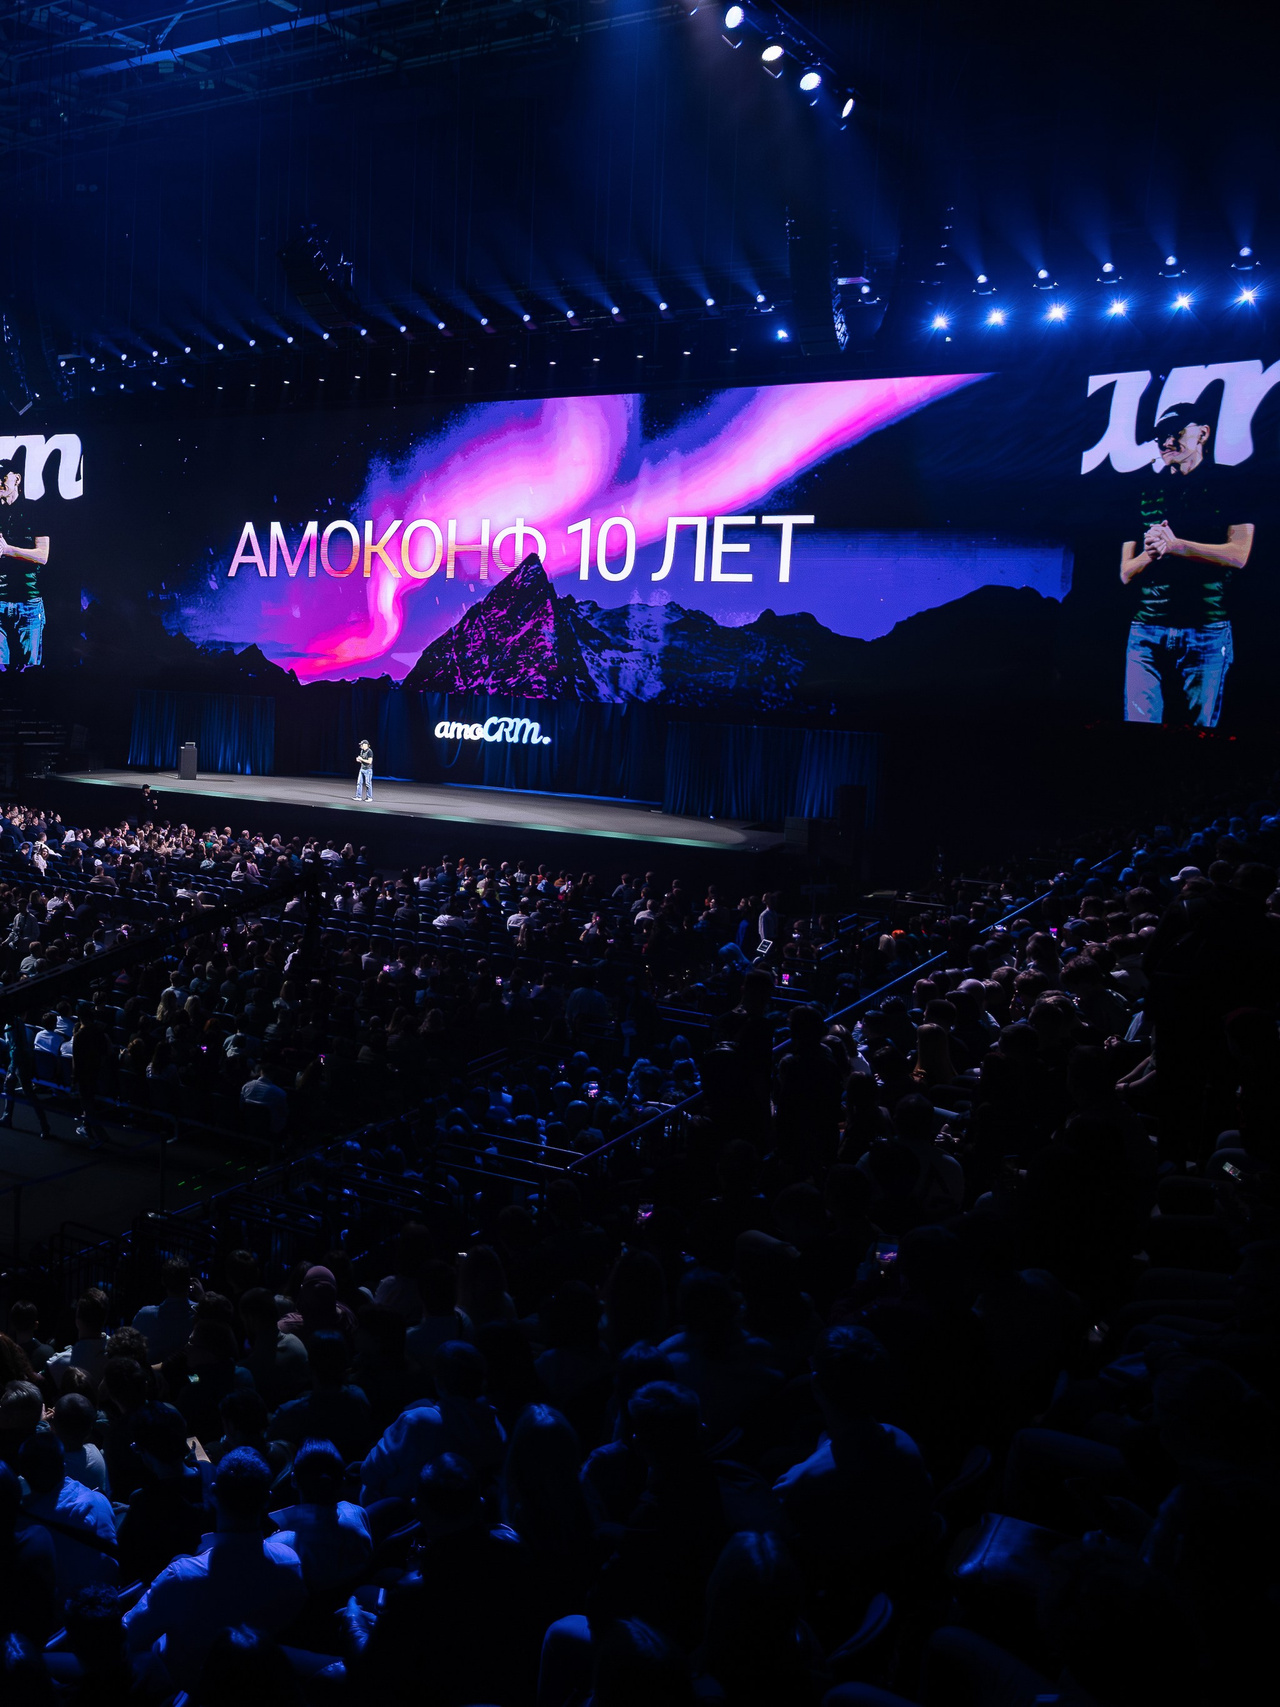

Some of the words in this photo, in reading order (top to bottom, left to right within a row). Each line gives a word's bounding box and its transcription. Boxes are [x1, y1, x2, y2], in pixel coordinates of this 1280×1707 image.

[227, 517, 547, 580] АМОКОНФ
[567, 516, 637, 582] 10
[651, 514, 815, 583] ЛЕТ
[434, 716, 552, 745] amoCRM.
